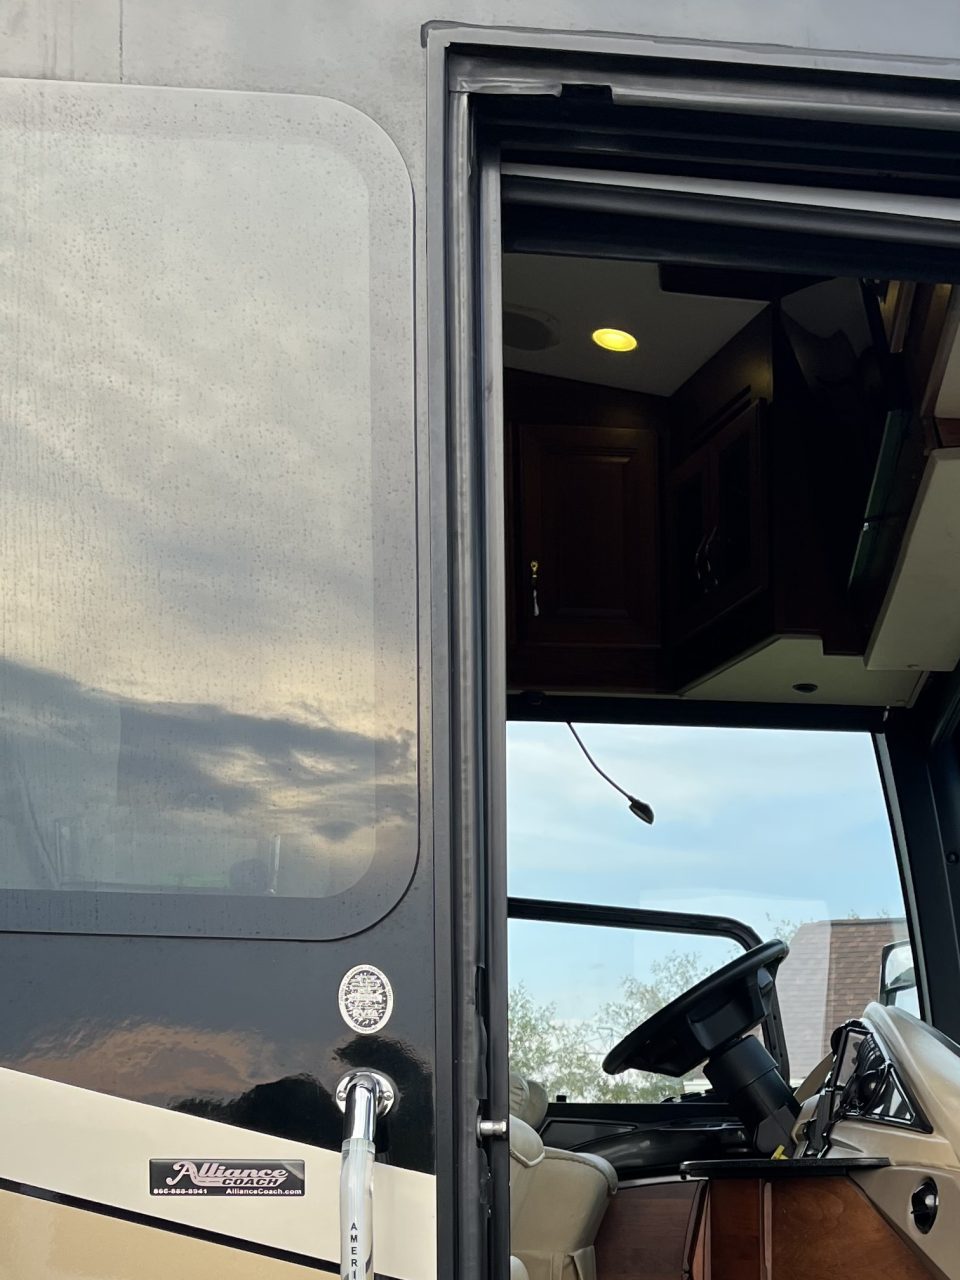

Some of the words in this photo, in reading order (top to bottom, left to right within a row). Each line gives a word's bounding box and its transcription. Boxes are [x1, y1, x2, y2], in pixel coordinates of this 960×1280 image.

[166, 1160, 288, 1186] Alliance
[222, 1178, 279, 1186] COACH
[225, 1187, 302, 1195] AllianceCoach.com
